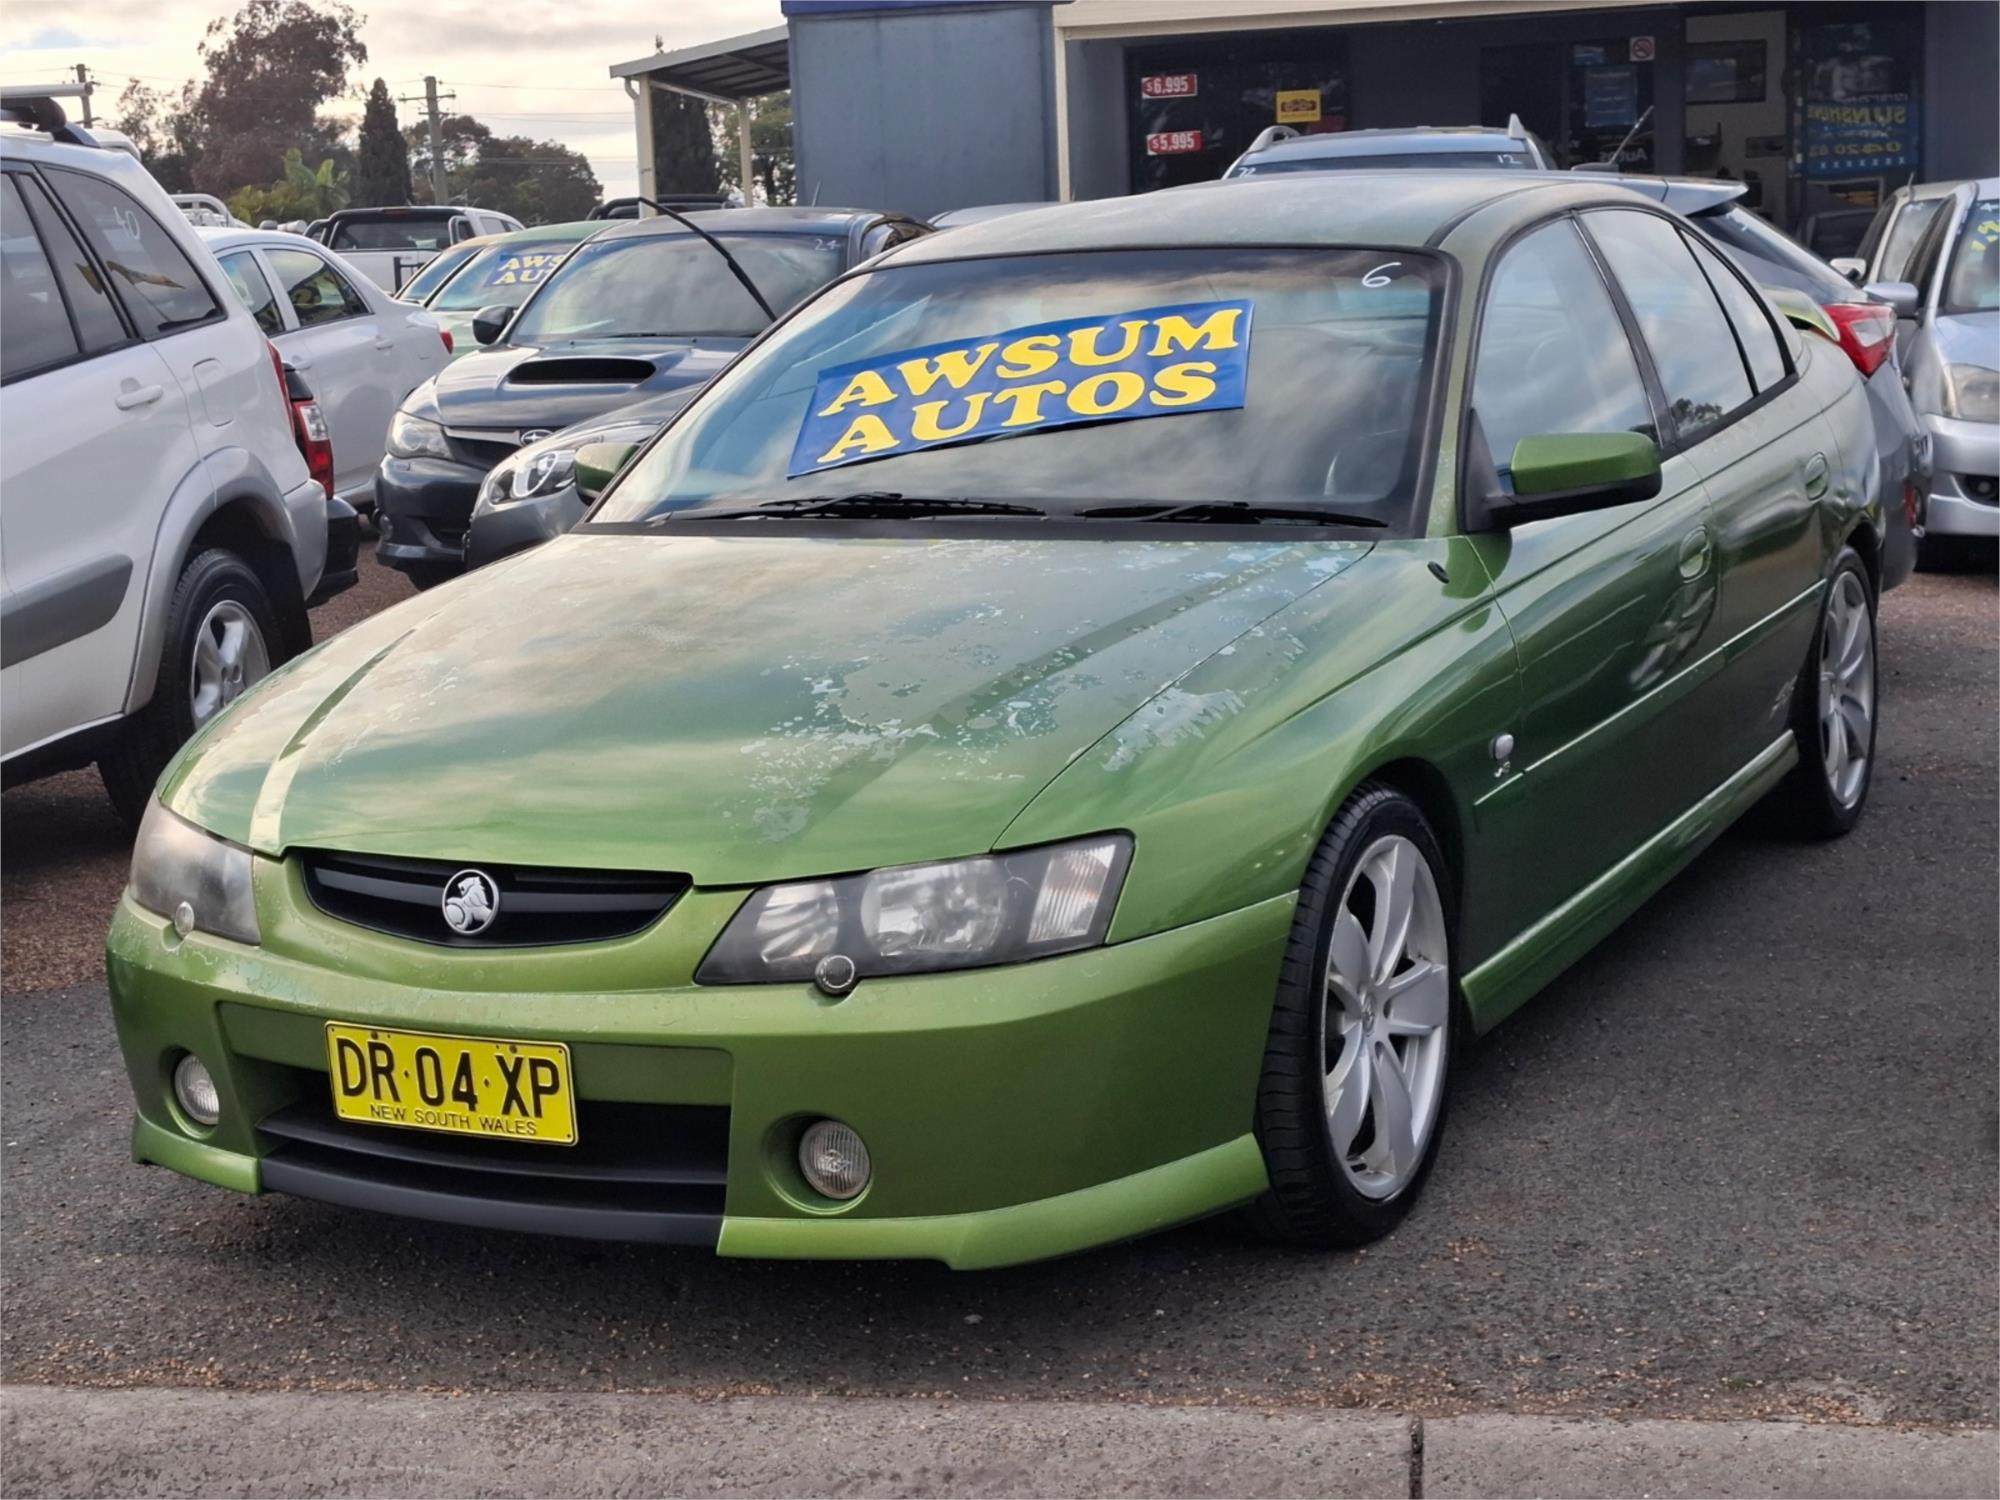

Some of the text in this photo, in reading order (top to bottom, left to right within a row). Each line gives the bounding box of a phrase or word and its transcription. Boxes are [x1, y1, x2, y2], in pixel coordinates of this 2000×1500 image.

[1146, 76, 1189, 94] $6,995
[1152, 133, 1195, 151] $5,995
[1361, 261, 1402, 288] 6
[818, 308, 1244, 417] AWSUM
[817, 361, 1217, 464] AUTOS
[370, 1103, 537, 1136] NEW SOUTH WALES
